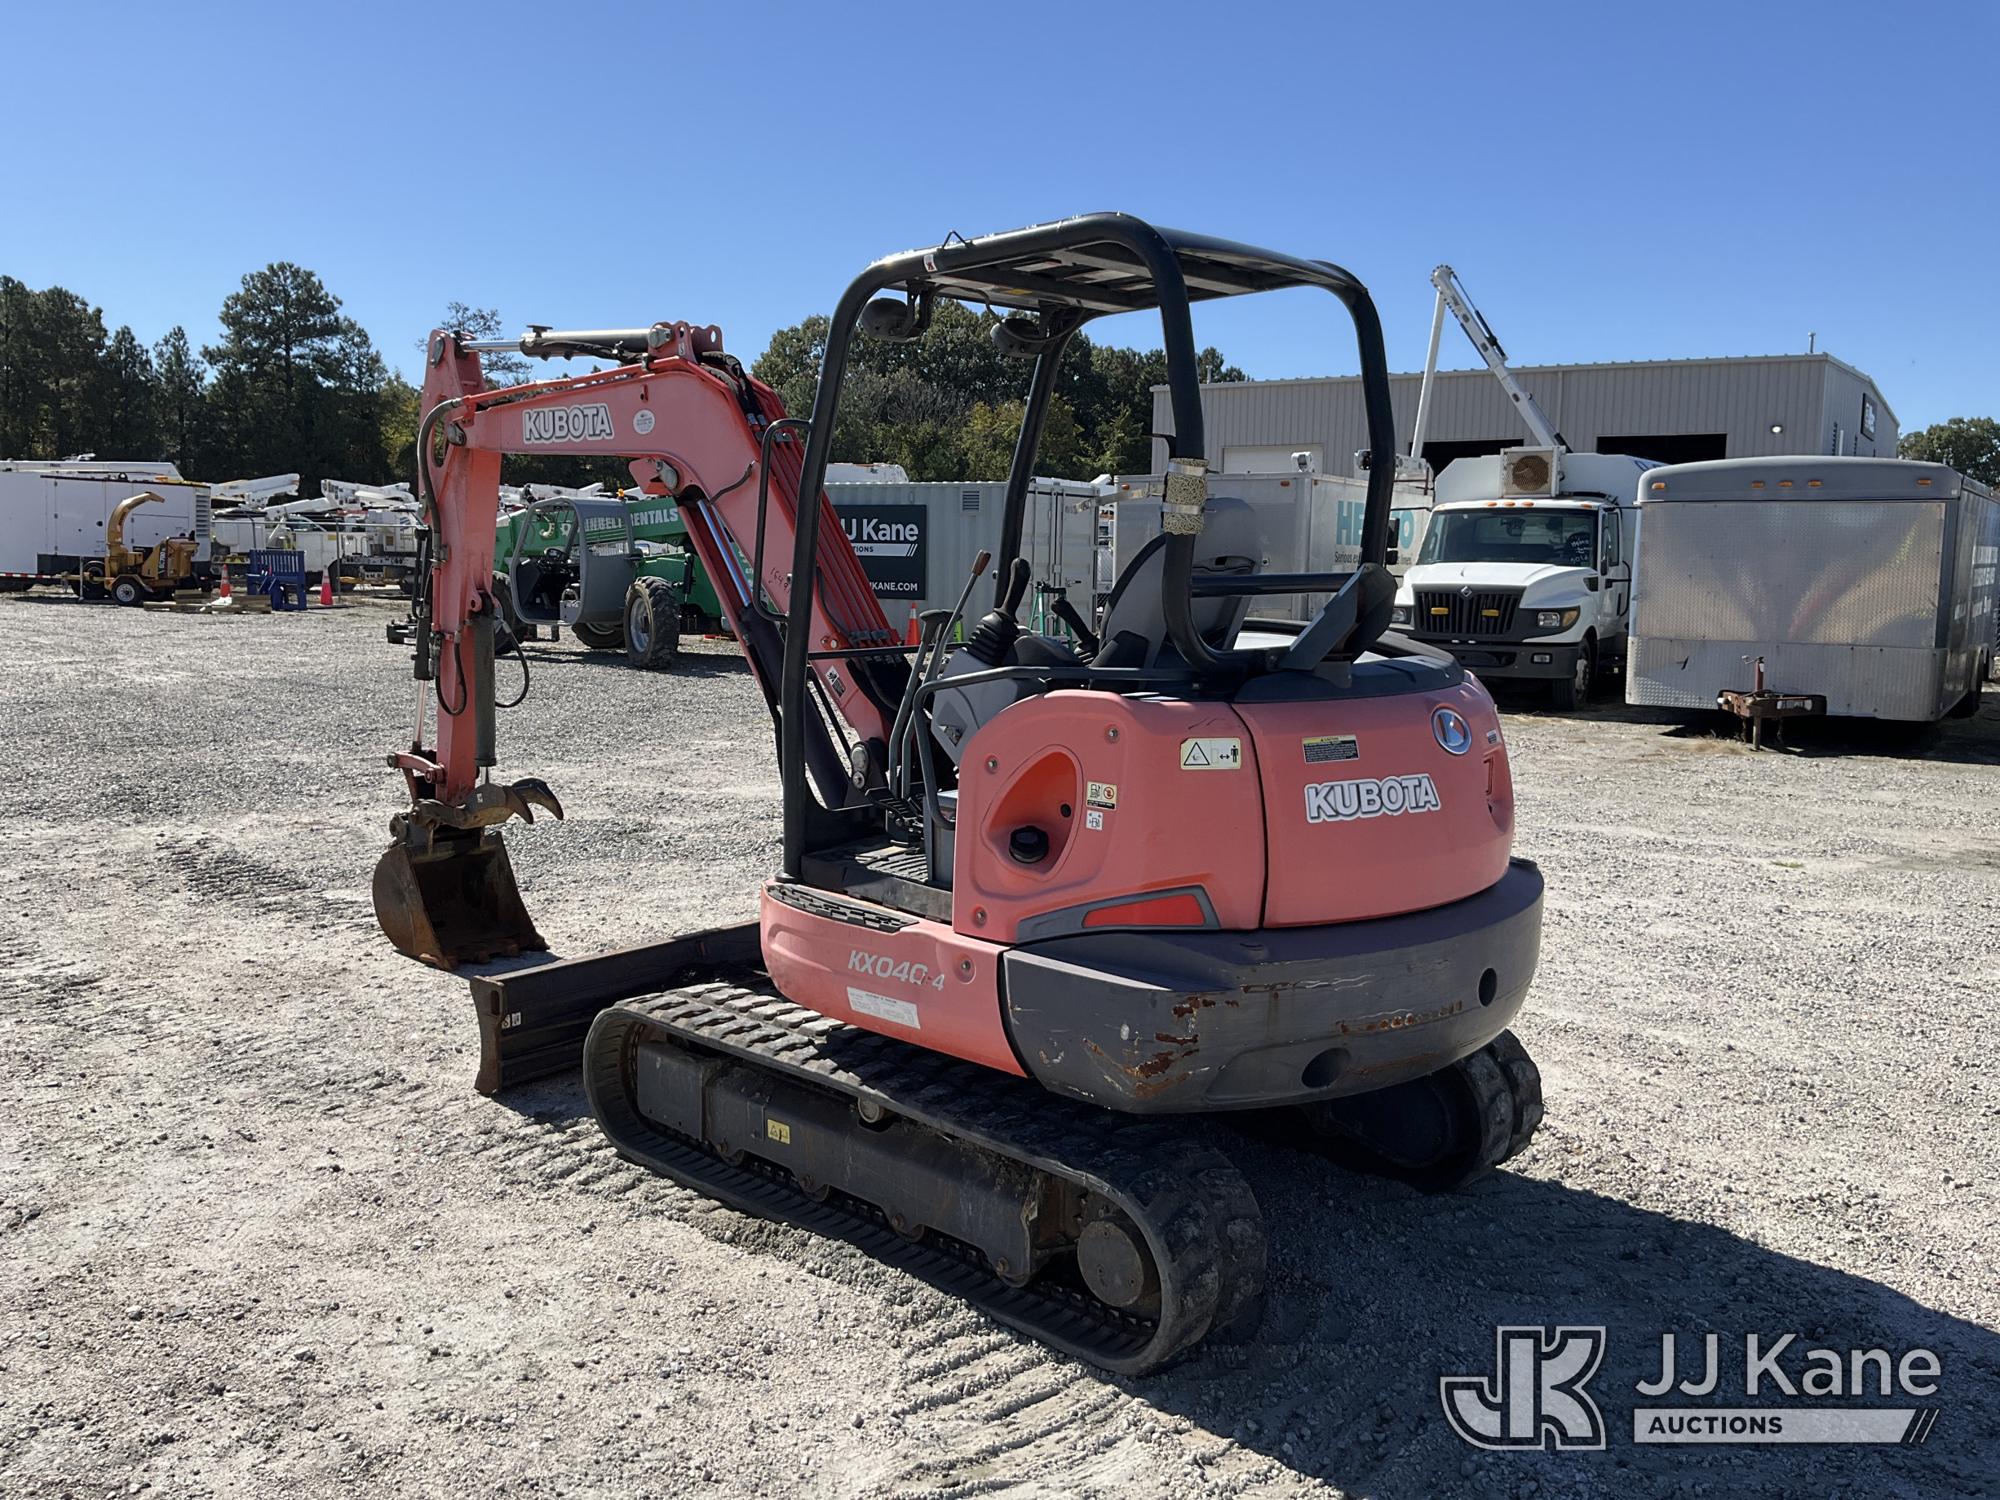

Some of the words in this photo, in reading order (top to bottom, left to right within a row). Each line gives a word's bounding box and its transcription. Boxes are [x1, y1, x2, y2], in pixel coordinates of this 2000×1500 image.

[523, 404, 614, 443] KUBOTA
[862, 518, 919, 541] Kane
[870, 582, 918, 591] KANE.COM
[1305, 774, 1440, 822] KUBOTA
